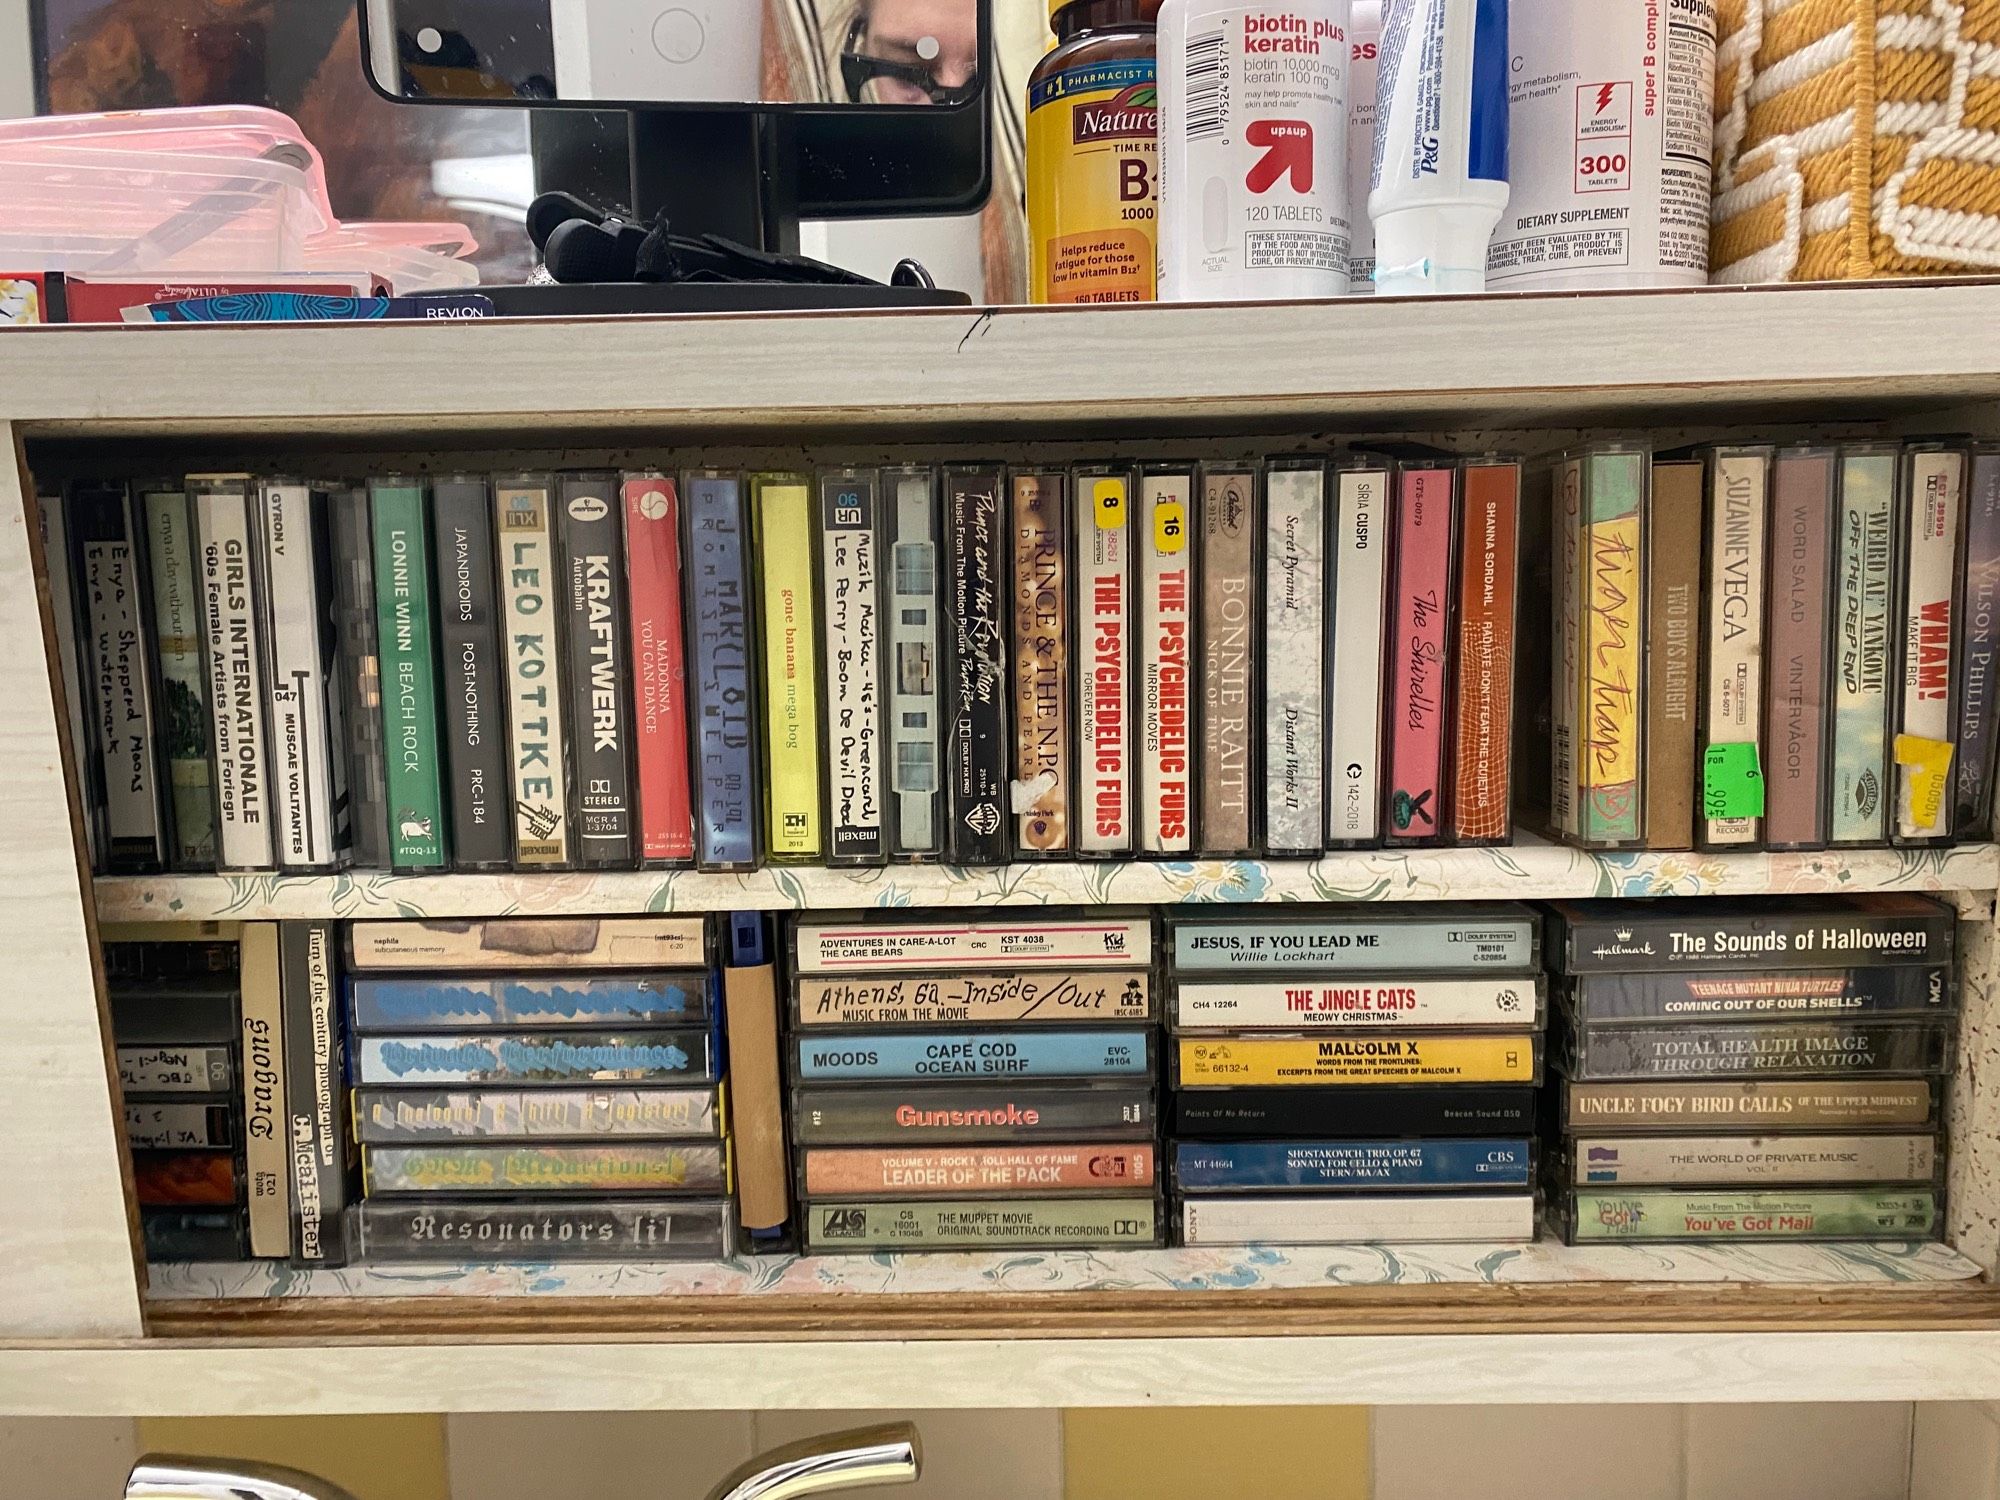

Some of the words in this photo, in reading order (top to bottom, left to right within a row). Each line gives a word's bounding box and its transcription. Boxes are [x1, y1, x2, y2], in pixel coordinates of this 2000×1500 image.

[1244, 14, 1306, 33] biotin
[1314, 19, 1344, 42] plus
[1244, 35, 1319, 54] keratin
[1644, 56, 1655, 66] B
[1244, 72, 1285, 84] keratin
[1291, 72, 1310, 84] 100
[1314, 75, 1328, 89] mg
[1644, 70, 1658, 117] super
[1113, 144, 1140, 153] TIME
[1271, 127, 1306, 137] up&up
[1421, 137, 1439, 174] P&G
[1580, 155, 1626, 175] 300
[1121, 208, 1154, 220] 1000
[1246, 207, 1269, 220] 120
[1272, 206, 1322, 222] TABLETS
[1518, 213, 1558, 230] DIETARY
[1560, 208, 1629, 223] SUPPLEMENT
[1055, 257, 1085, 271] fatigue
[1087, 255, 1102, 264] for
[1104, 253, 1134, 262] those
[1061, 246, 1087, 257] Helps
[1089, 241, 1125, 253] reduce
[1103, 497, 1117, 508] 8
[1356, 484, 1372, 509] SÍRIA
[1165, 516, 1179, 536] 16
[1286, 515, 1299, 553] Secret
[1355, 513, 1369, 550] CUSPO
[1848, 509, 1860, 548] OFF
[225, 539, 245, 610] GIRLS
[392, 531, 408, 597] LONNIE
[454, 528, 473, 621] JAPANDROIDS
[513, 541, 542, 615] LEO
[1846, 552, 1860, 591] THE
[573, 557, 585, 611] Autobahn
[1094, 574, 1121, 618] THE
[1159, 570, 1185, 616] THE
[1282, 555, 1299, 610] Pyramid
[1667, 584, 1689, 615] TWO
[207, 583, 223, 645] Female
[781, 589, 796, 623] gone
[1412, 590, 1437, 627] The
[1845, 596, 1859, 650] DEEP
[396, 603, 411, 651] WINN
[641, 619, 654, 648] YOU
[1221, 577, 1245, 705] BONNIE
[1666, 620, 1688, 658] BOYS
[586, 555, 617, 752] KRAFTWERK
[643, 652, 655, 680] CAN
[784, 628, 797, 679] banana
[1206, 640, 1217, 680] NICK
[1919, 601, 1950, 700] WHAM!
[213, 651, 228, 708] Artists
[657, 640, 670, 713] MADONNA
[1146, 663, 1157, 709] MIRROR
[1408, 637, 1435, 731] Shirelles
[1844, 649, 1858, 694] END
[399, 662, 414, 719] BEACH
[462, 643, 479, 746] POST-NOTHING
[783, 684, 799, 720] mega
[1083, 672, 1093, 716] FOREVER
[1094, 622, 1121, 773] PSYCHEDELIC
[1159, 622, 1185, 774] PSYCHEDELIC
[1206, 688, 1218, 708] OF
[1664, 661, 1686, 721] ALRIGHT
[229, 619, 259, 824] INTERNATIONALE
[515, 634, 553, 800] KOTTKE
[644, 686, 657, 734] DANCE
[218, 714, 232, 752] from
[285, 713, 298, 768] MUSCAE
[786, 724, 800, 748] bog
[1083, 719, 1093, 742] NOW
[1147, 713, 1158, 752] MOVES
[1207, 715, 1218, 753] TIME
[1285, 709, 1299, 755] Distant
[402, 725, 418, 773] ROCK
[1220, 717, 1245, 815] RAITT
[220, 759, 237, 821] Foriegn
[1285, 758, 1299, 794] Works
[289, 772, 303, 854] VOLITANTES
[471, 769, 485, 824] PRC-184
[585, 796, 620, 805] STEREO
[1095, 780, 1122, 838] FURS
[1159, 782, 1185, 840] FURS
[1285, 797, 1299, 810] II
[838, 829, 877, 842] maxell
[820, 937, 884, 948] ADVENTURES
[887, 938, 897, 947] IN
[899, 937, 956, 947] CARE-A-LOT
[821, 949, 838, 958] THE
[842, 948, 868, 958] CARE
[871, 947, 903, 957] BEARS
[1190, 936, 1245, 951] JESUS,
[1250, 937, 1265, 948] IF
[1269, 936, 1304, 948] YOU
[1308, 936, 1351, 948] LEAD
[1355, 935, 1379, 947] ME
[1230, 952, 1268, 963] Willie
[1273, 951, 1334, 962] Lockhart
[1591, 942, 1656, 960] Hallmark
[1670, 932, 1706, 953] The
[1713, 930, 1786, 952] Sounds
[1795, 930, 1815, 950] of
[1821, 929, 1927, 950] Halloween
[1285, 989, 1313, 1011] THE
[1318, 990, 1373, 1010] JINGLE
[1377, 989, 1416, 1009] CATS
[1665, 1001, 1721, 1012] COMING
[1724, 1000, 1754, 1011] OUT
[1756, 1000, 1775, 1010] OF
[1778, 999, 1807, 1010] OUR
[1809, 997, 1862, 1008] SHELLS
[1692, 983, 1734, 996] TEENAGE
[1735, 983, 1773, 995] MUTANT
[1775, 982, 1801, 993] NINJA
[1802, 980, 1844, 992] TURTLES
[1928, 971, 1941, 1004] MCA
[842, 1009, 874, 1021] MUSIC
[879, 1008, 907, 1021] FROM
[912, 1008, 933, 1020] THE
[937, 1008, 969, 1020] MOVIE
[1303, 1012, 1338, 1022] MEOWY
[1342, 1012, 1398, 1022] CHRISTMAS
[813, 1052, 878, 1067] MOODS
[926, 1043, 973, 1058] CAPE
[980, 1043, 1016, 1058] COD
[1318, 1042, 1401, 1057] MALCOLM
[1406, 1042, 1419, 1056] X
[1651, 1057, 1747, 1073] THROUGH
[1752, 1053, 1876, 1070] RELAXATION
[1653, 1041, 1715, 1057] TOTAL
[1719, 1039, 1803, 1055] HEALTH
[1805, 1036, 1868, 1052] IMAGE
[245, 1018, 278, 1141] Dragons
[915, 1060, 977, 1074] OCEAN
[982, 1060, 1029, 1074] SURF
[896, 1104, 1039, 1127] Gunsmoke
[1487, 1152, 1514, 1163] CBS
[883, 1167, 948, 1186] LEADER
[953, 1167, 975, 1185] OF
[979, 1167, 1011, 1184] THE
[1016, 1167, 1061, 1184] PACK
[937, 1213, 955, 1224] THE
[959, 1213, 999, 1224] MUPPET
[1002, 1213, 1033, 1224] MOVIE
[937, 1226, 981, 1236] ORIGINAL
[986, 1226, 1050, 1236] SOUNDTRACK
[1055, 1226, 1109, 1236] RECORDING
[1189, 1206, 1197, 1242] SONY
[1684, 1216, 1737, 1233] You've
[1742, 1216, 1774, 1231] Got
[1779, 1215, 1814, 1231] Mail
